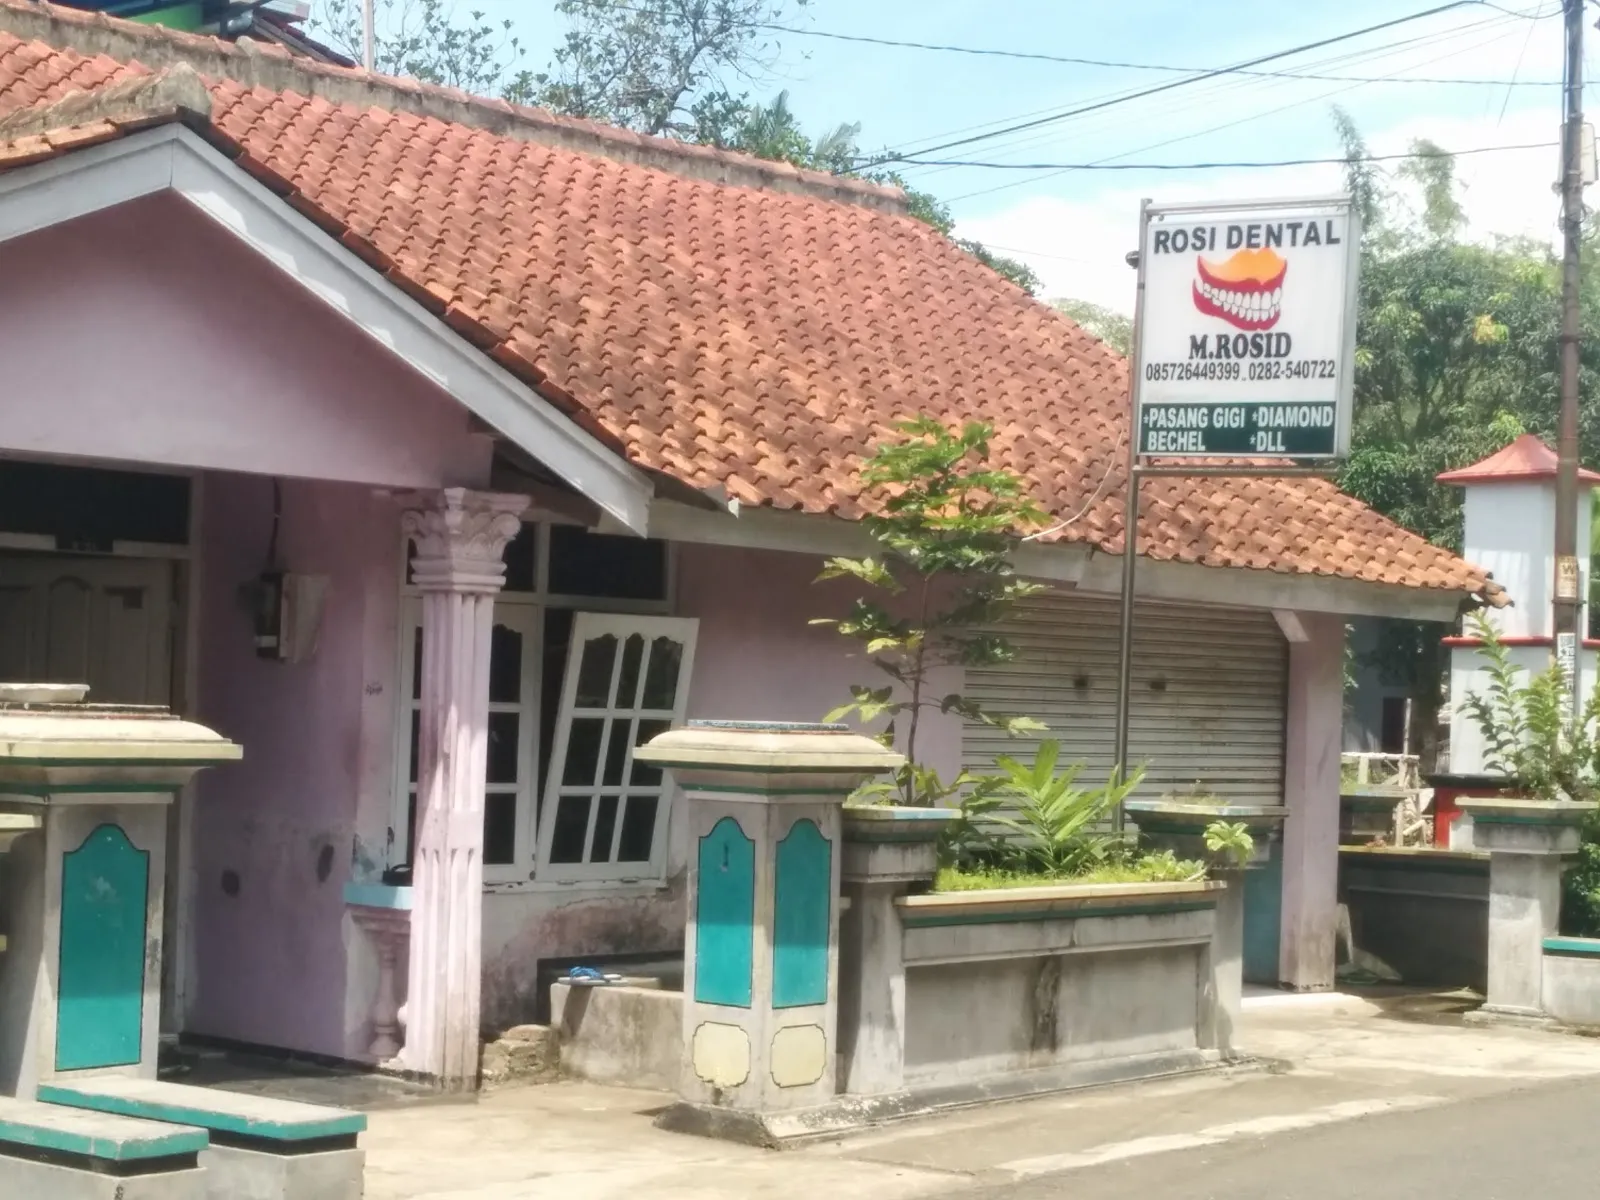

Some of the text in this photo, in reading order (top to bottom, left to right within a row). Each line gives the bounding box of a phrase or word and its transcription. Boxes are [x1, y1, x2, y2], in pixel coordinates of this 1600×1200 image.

[1154, 220, 1341, 254] ROSI DENTAL
[1188, 332, 1292, 360] M.ROSID
[1249, 360, 1336, 380] 0282-540722
[1213, 407, 1245, 428] GIGI
[1148, 431, 1206, 452] BECHEL
